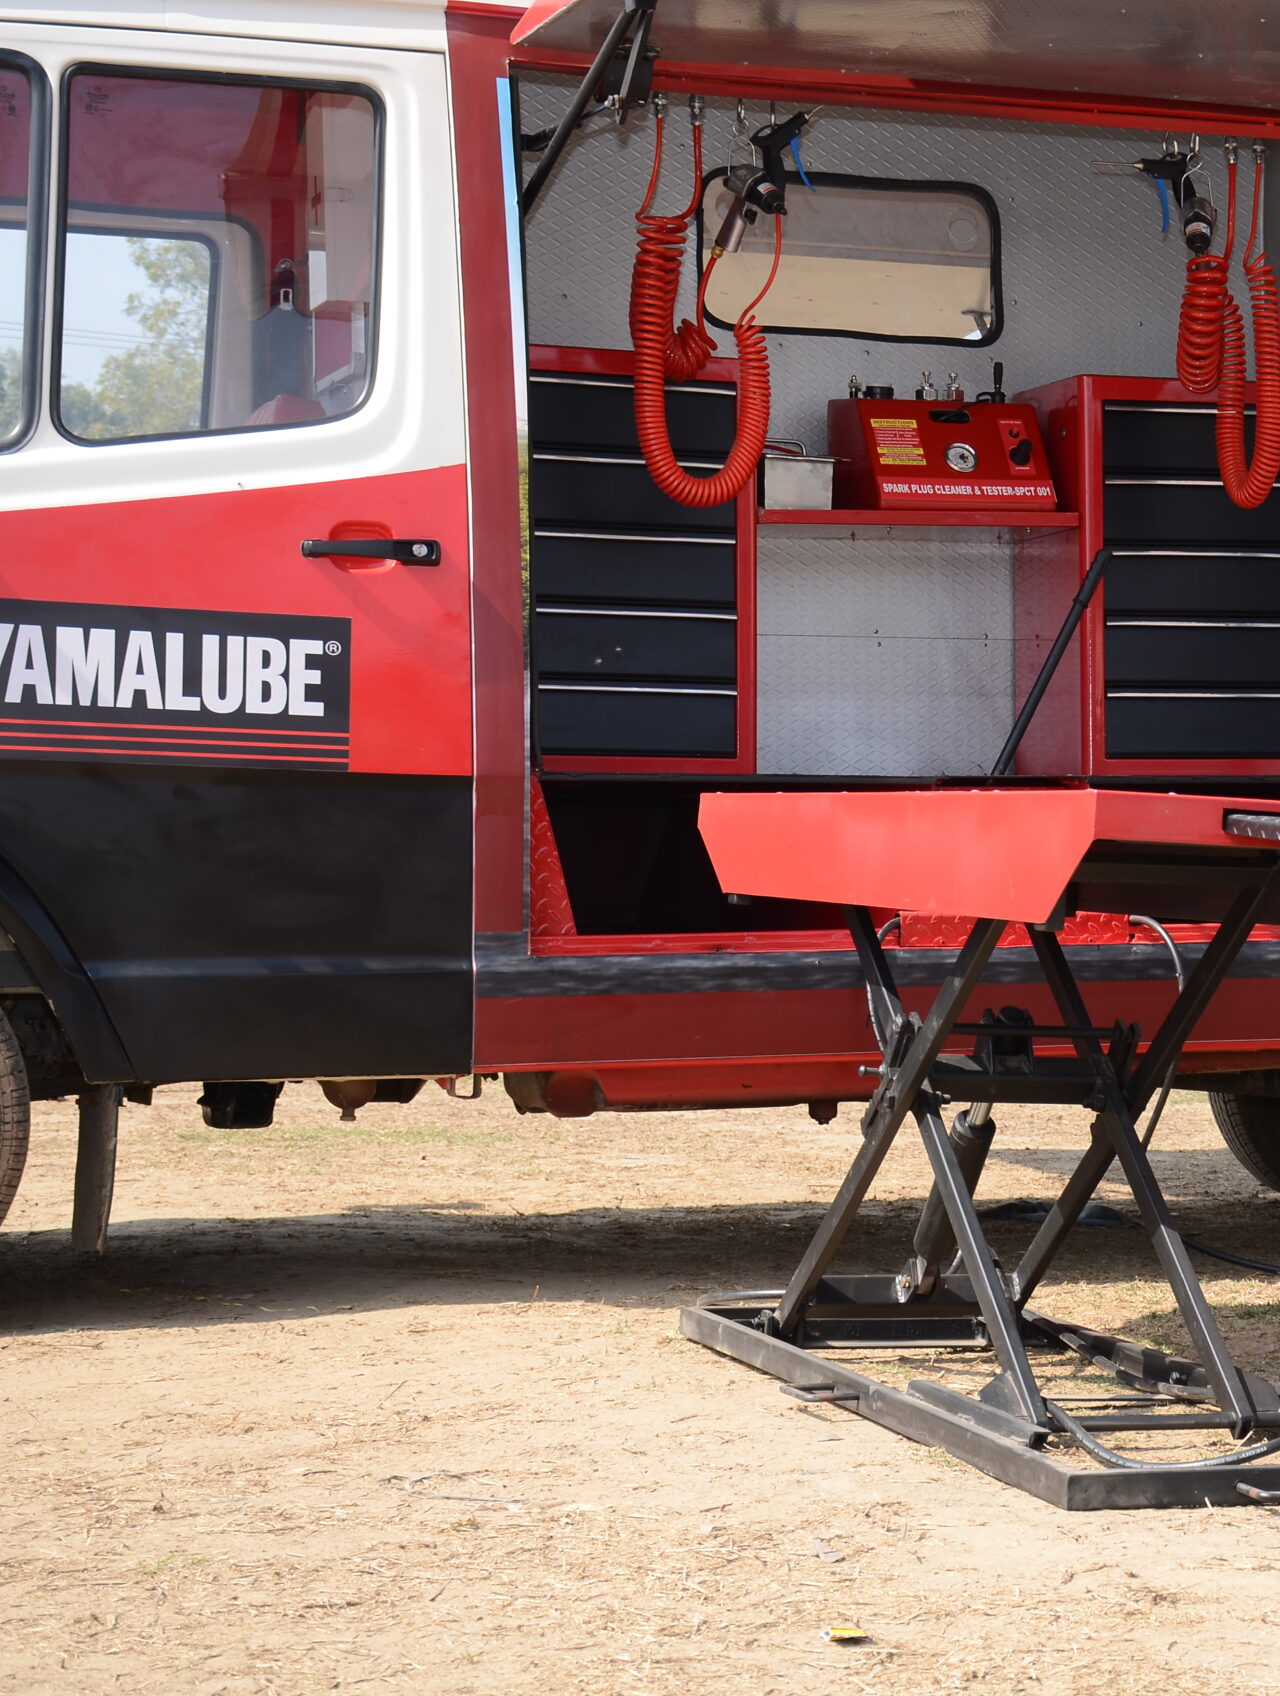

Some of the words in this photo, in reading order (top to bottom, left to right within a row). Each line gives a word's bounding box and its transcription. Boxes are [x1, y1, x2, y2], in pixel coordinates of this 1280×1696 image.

[882, 483, 910, 493] SPARK
[911, 484, 934, 494] PLUG
[935, 485, 973, 495] CLEANER
[974, 486, 982, 495] &
[1036, 487, 1051, 496] 001
